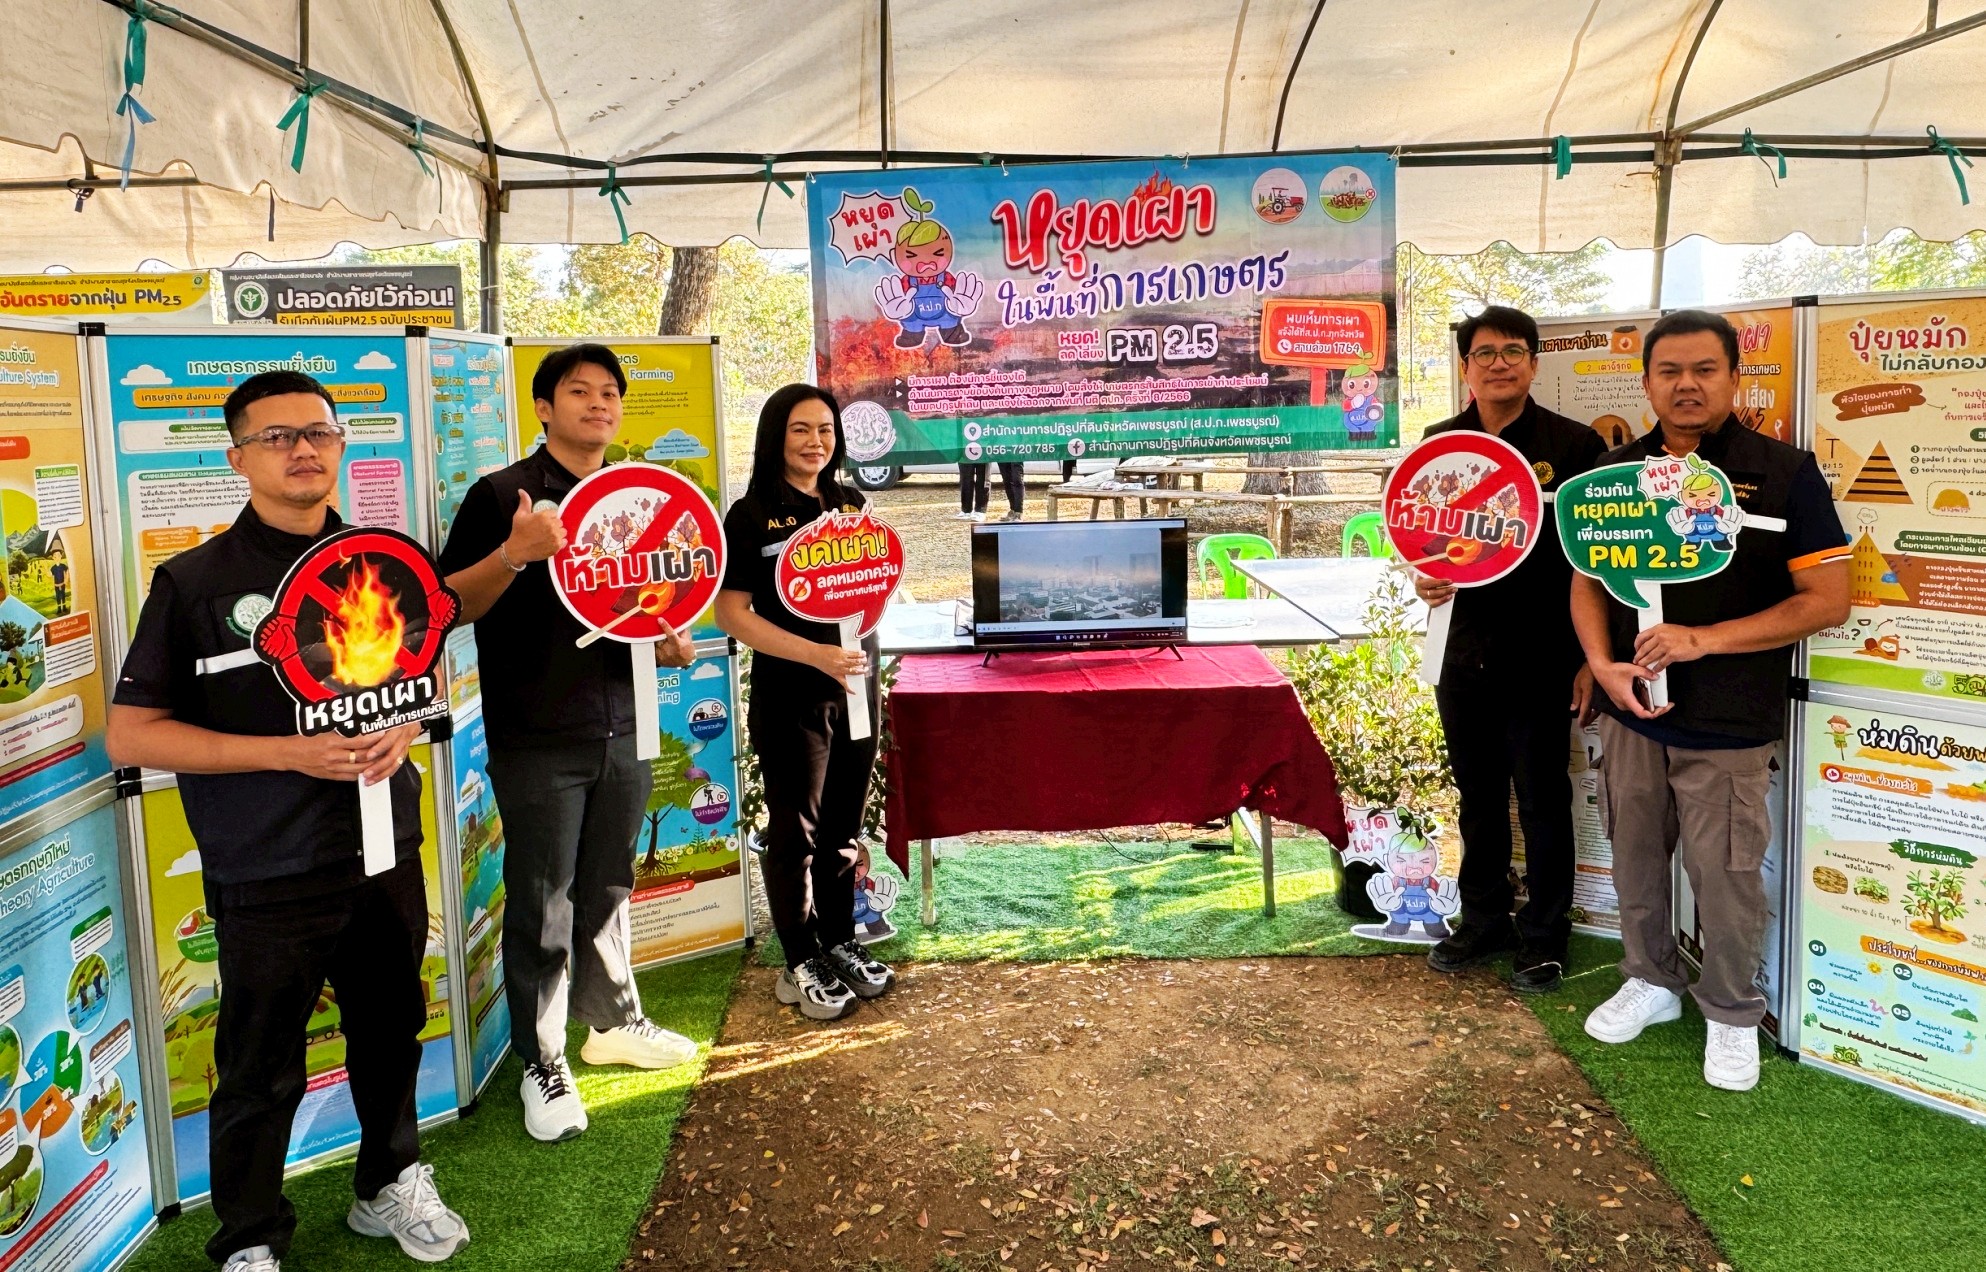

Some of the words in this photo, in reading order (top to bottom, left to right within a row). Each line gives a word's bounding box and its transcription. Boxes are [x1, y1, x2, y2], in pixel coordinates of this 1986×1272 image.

[841, 202, 895, 231] หยุด
[853, 228, 893, 252] เผา
[991, 184, 1216, 280] หยุดเผา
[277, 283, 455, 309] ปลอดภัยไว้ก่อน!
[996, 249, 1292, 329] ในพื้นที่การเกษตร
[380, 313, 452, 325] ฉบับประชาชน
[1286, 309, 1360, 326] พบเห็นการเผา
[1058, 328, 1101, 349] หยุด!
[1107, 329, 1157, 364] PM
[1162, 323, 1219, 363] 2.5
[1294, 339, 1331, 354] สายด่วน
[1538, 330, 1609, 353] เตาเผาถ่าน
[1849, 316, 1967, 363] ปุ๋ยหมัก
[188, 351, 336, 375] เกษตรกรรมยั่งยืน
[1058, 347, 1077, 362] ลด
[1078, 346, 1105, 362] เลี่ยง
[26, 370, 59, 389] System)
[630, 369, 674, 381] Farming
[908, 374, 947, 387] มีการเผา
[948, 369, 1027, 386] ต้องมีการชี้แจงได้
[1153, 391, 1191, 403] 8/2566
[1745, 379, 1776, 409] เสี่ยง
[1841, 385, 1913, 404] หัวใจของการทำ
[1861, 402, 1895, 415] ปุ๋ยหมัก
[982, 417, 1188, 437] สำนักงานการปฏิรูปที่ดินจังหวัดเพชรบูรณ์
[1190, 414, 1280, 431] (ส.ป.ก.เพชรบูรณ์)
[985, 443, 1032, 455] 056-720
[1088, 433, 1292, 453] สำนักงานการปฏิรูปที่ดินจังหวัดเพชรบูรณ์
[1645, 463, 1682, 480] หยุด
[1584, 483, 1633, 498] ร่วมกัน
[1654, 479, 1680, 494] เผา
[767, 516, 797, 530] ALO
[1389, 488, 1528, 548] ห้ามเผา
[1573, 500, 1658, 525] หยุดเผา
[1577, 523, 1654, 541] เพื่อบรรเทา
[790, 527, 888, 571] งดเผา!
[1589, 545, 1637, 569] PM
[1647, 544, 1699, 569] 2.5
[563, 543, 718, 593] ห้ามเผา
[816, 561, 899, 589] ลดหมอกควัน
[304, 675, 433, 729] หยุดเผา
[360, 700, 449, 734] ในพื้นที่การเกษตร
[1346, 815, 1389, 837] หยุด
[1353, 835, 1386, 853] เผา
[1903, 841, 1963, 866] วิธีการห่มดิน
[37, 852, 95, 896] Agriculture
[1811, 943, 1824, 954] 01
[1894, 966, 1911, 978] 02
[1809, 981, 1825, 993] 04
[1893, 1007, 1910, 1018] 05
